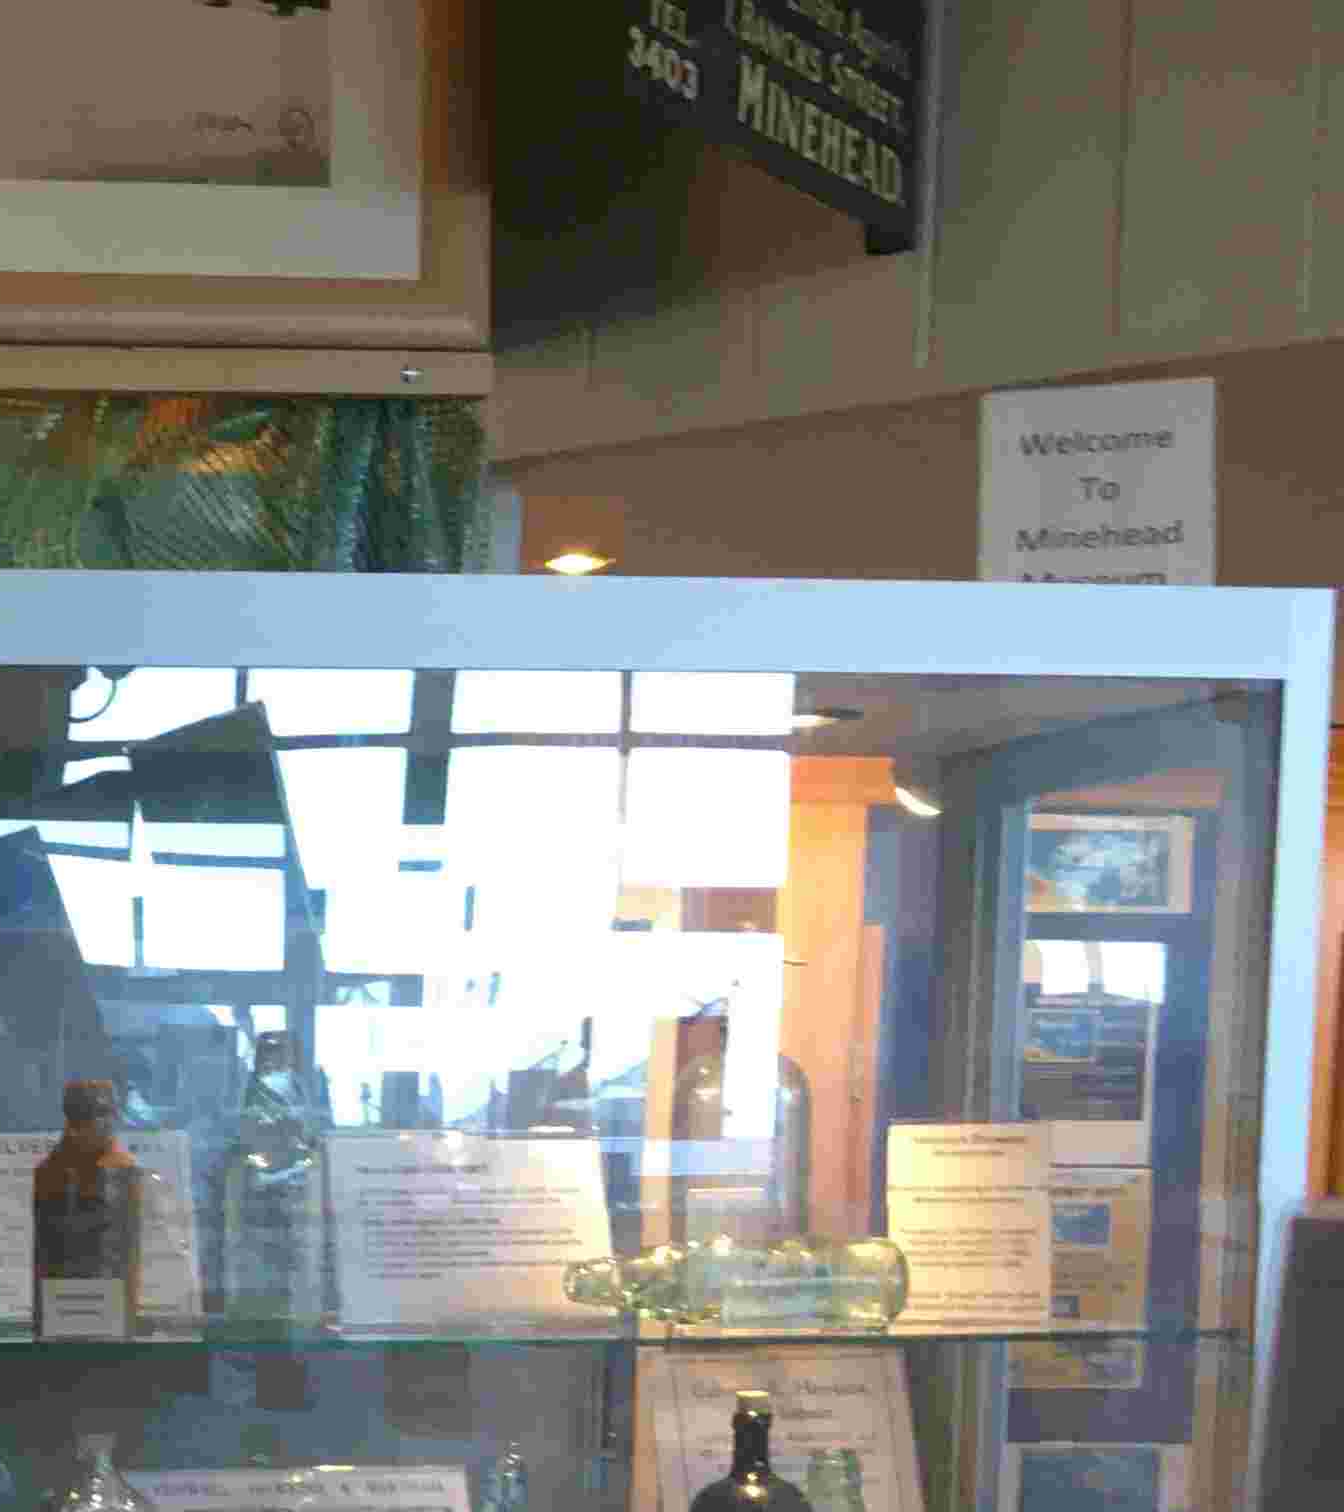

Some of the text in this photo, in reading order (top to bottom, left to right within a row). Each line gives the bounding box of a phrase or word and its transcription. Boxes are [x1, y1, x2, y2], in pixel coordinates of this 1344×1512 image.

[1017, 429, 1174, 456] Welcome
[1077, 475, 1118, 501] To
[1014, 520, 1183, 552] Minehead
